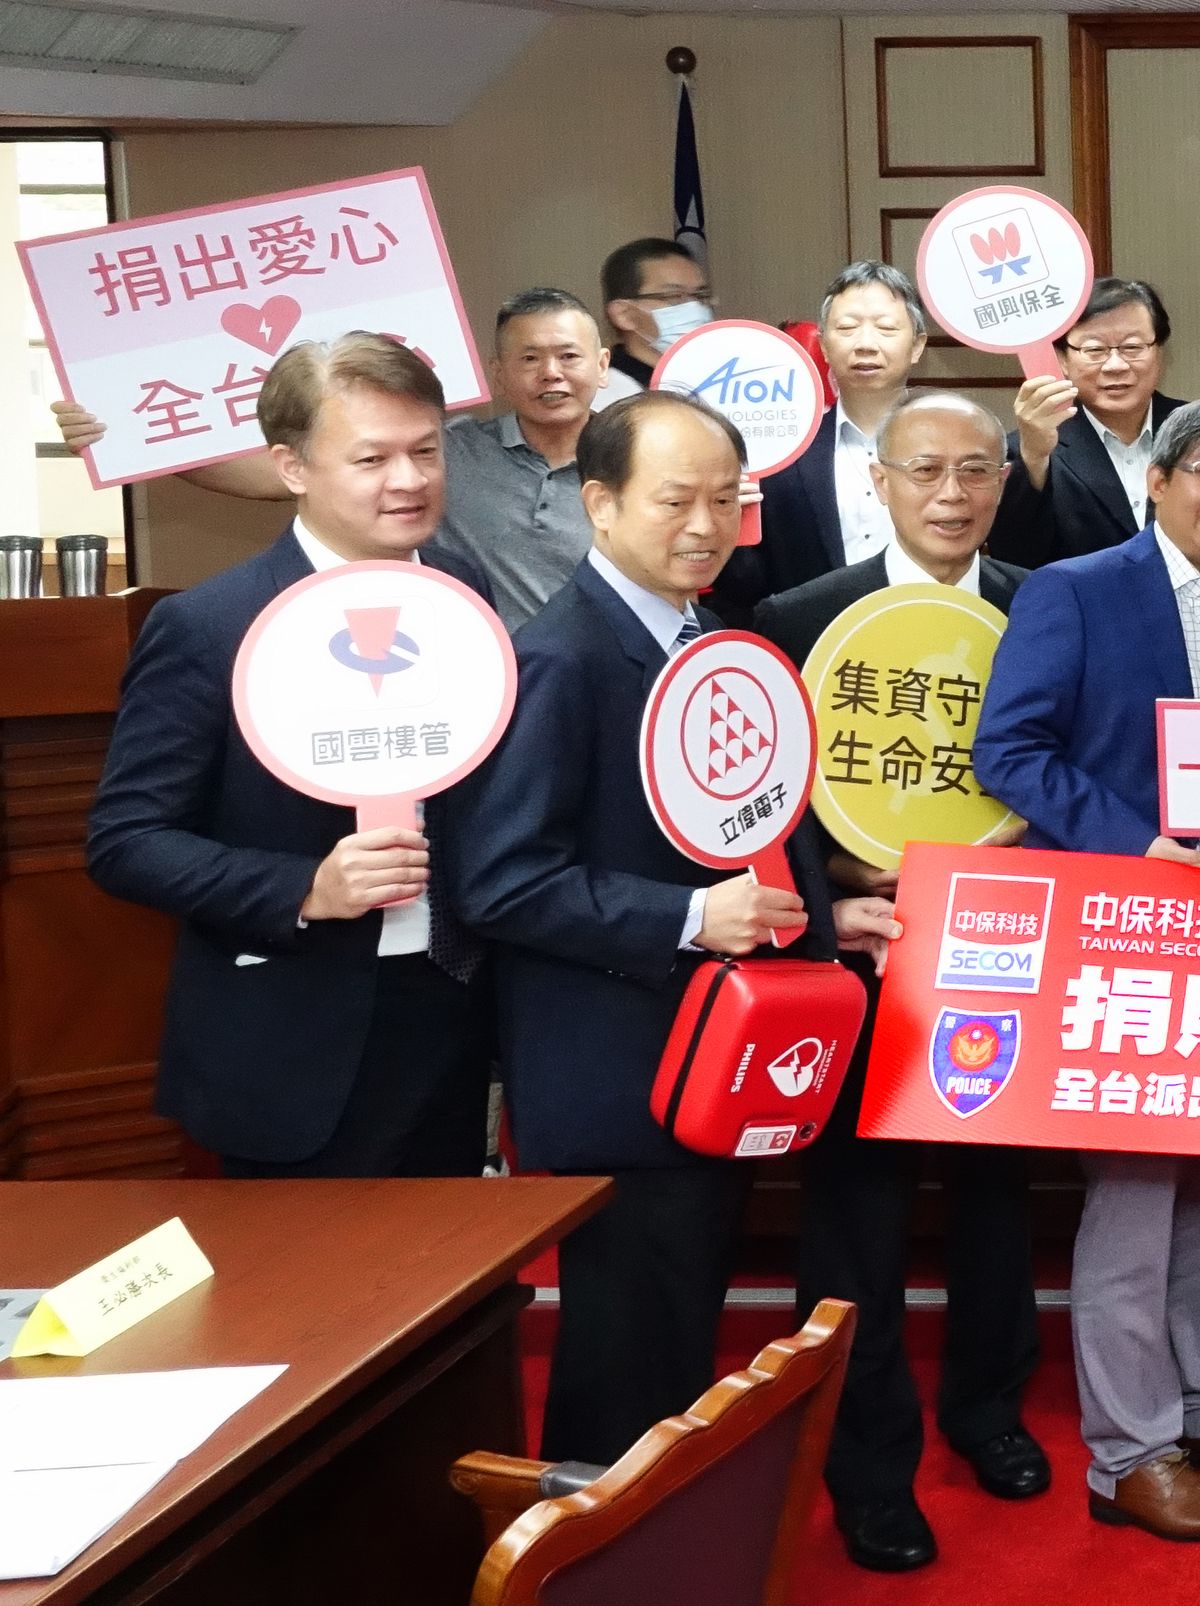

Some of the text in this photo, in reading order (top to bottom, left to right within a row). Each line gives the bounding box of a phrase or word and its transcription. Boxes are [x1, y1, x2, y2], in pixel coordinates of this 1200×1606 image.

[88, 206, 400, 317] 捐出愛心
[973, 284, 1064, 330] 國興保全
[688, 357, 796, 404] AION
[727, 409, 797, 421] OLOGIES
[311, 722, 451, 765] 國雲樓管
[825, 730, 993, 797] 生命安
[719, 782, 788, 845] 立偉電子
[955, 910, 1039, 935] 中保科技
[1079, 936, 1154, 954] TAIWAN
[950, 949, 1032, 972] SECOM
[731, 1043, 756, 1092] PHILIPS
[815, 1040, 838, 1094] HEARTSTART
[946, 1076, 992, 1095] POLICE
